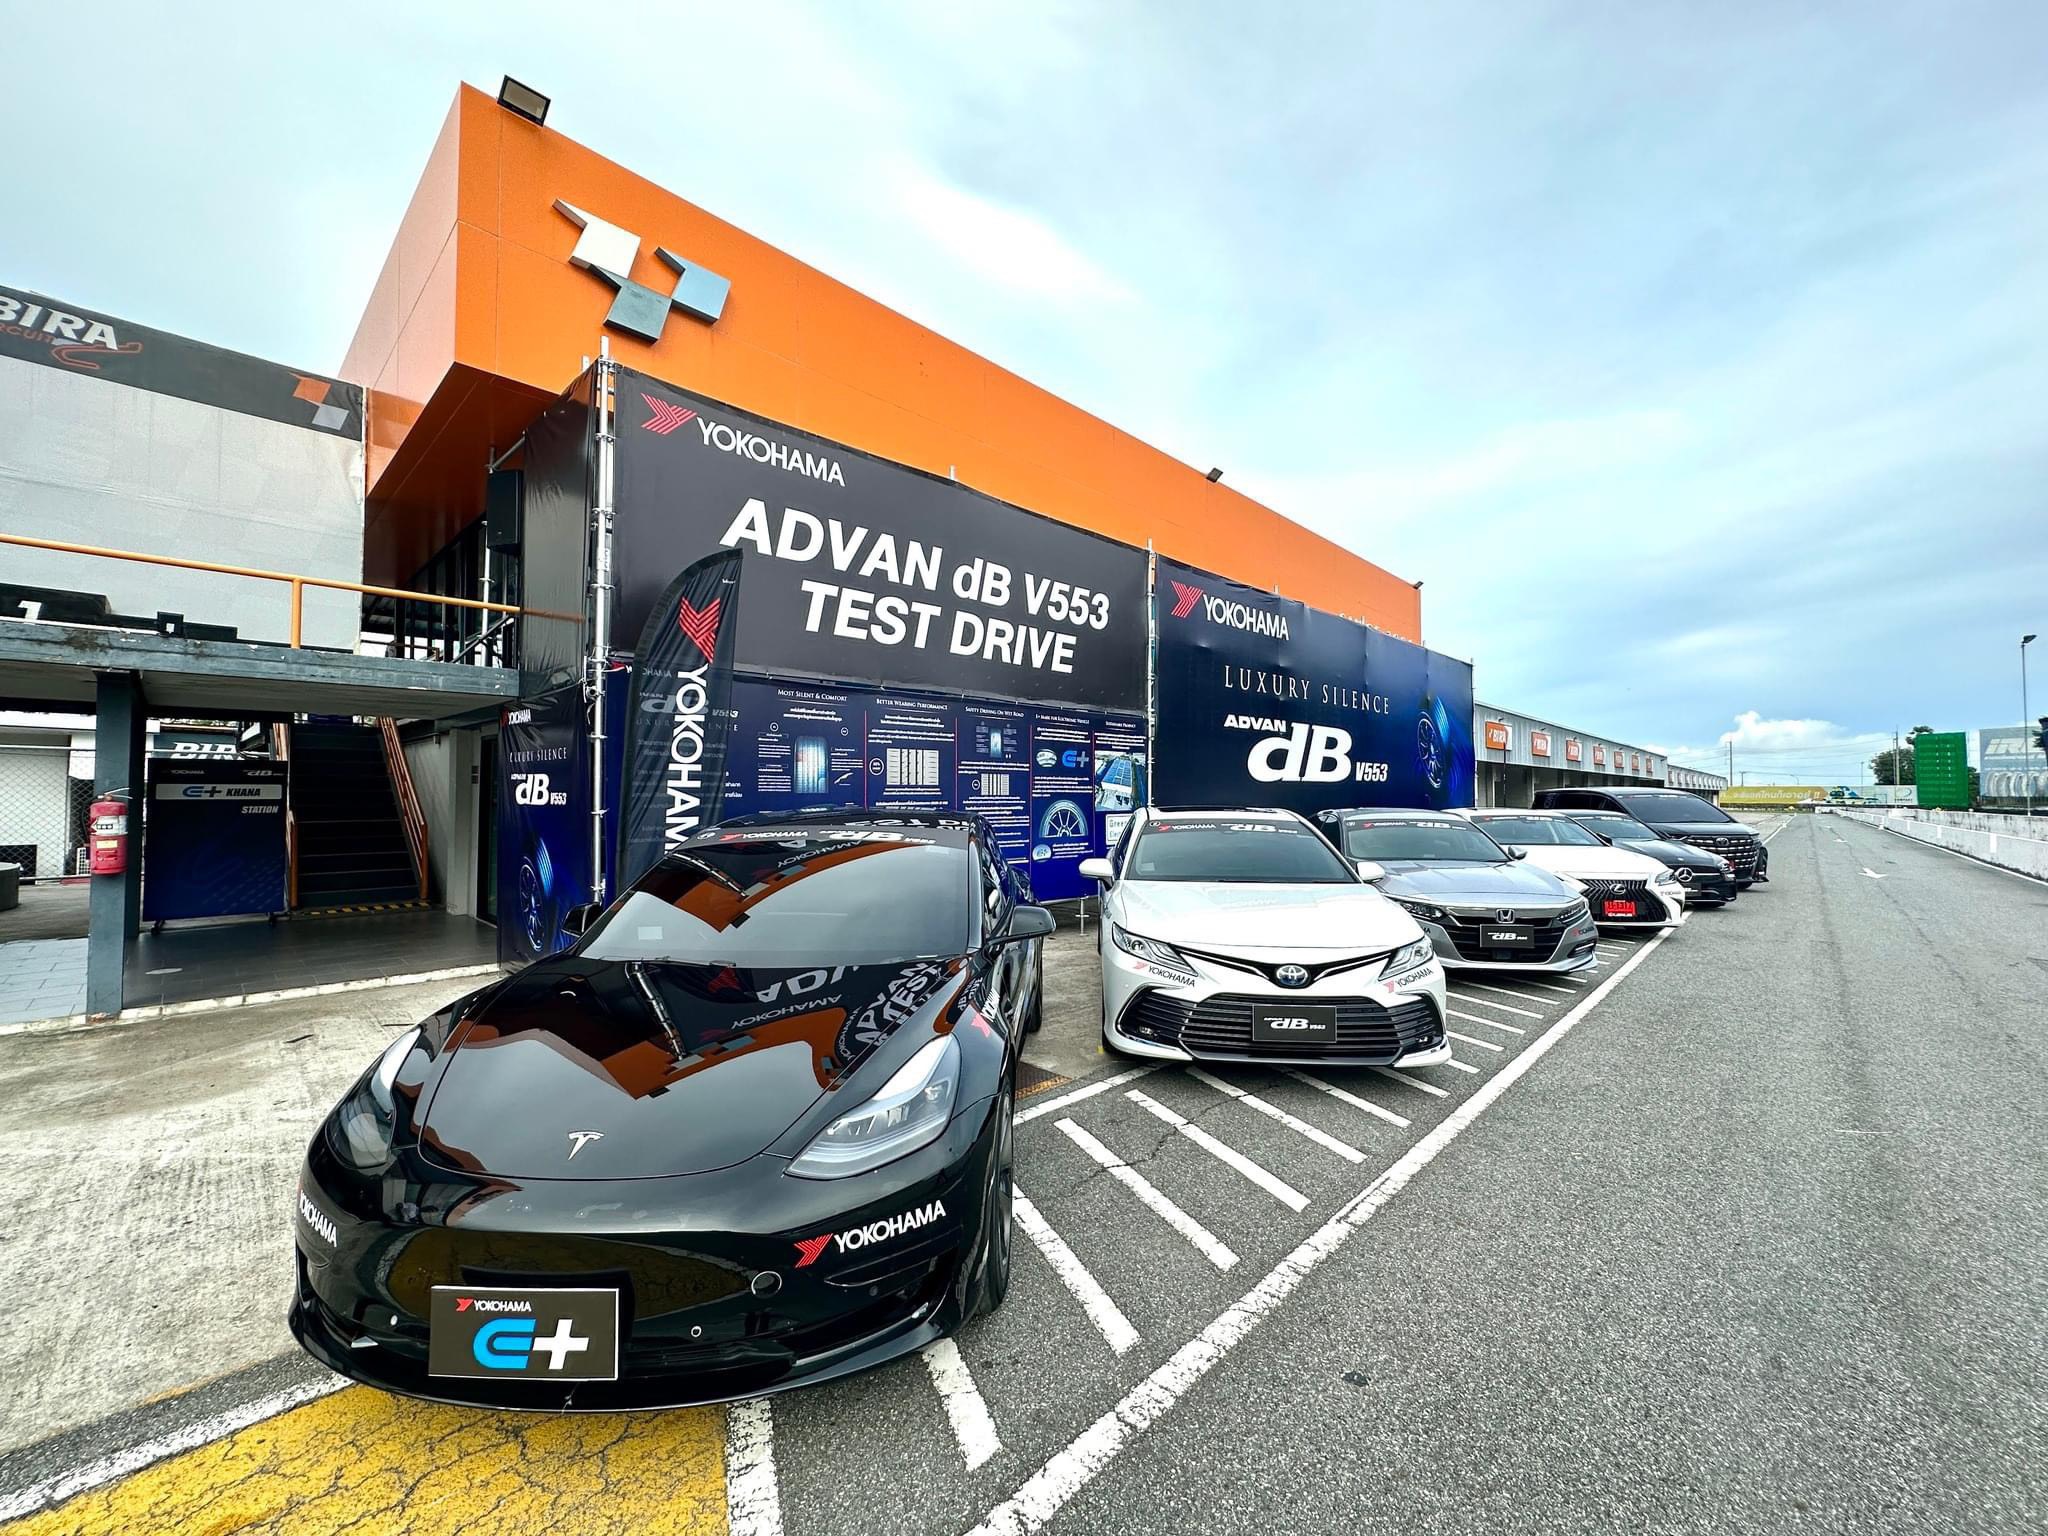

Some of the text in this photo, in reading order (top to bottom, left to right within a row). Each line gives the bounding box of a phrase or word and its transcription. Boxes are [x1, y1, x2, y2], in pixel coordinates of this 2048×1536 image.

[696, 416, 845, 487] YOKOHAMA
[719, 497, 1110, 630] ADVAN dB V553
[801, 579, 1077, 674] TEST DRIVE
[1203, 594, 1289, 641] YOKOHAMA
[778, 689, 794, 697] MOST
[796, 691, 814, 699] SILENT
[822, 693, 847, 702] COMFORT
[1224, 664, 1389, 715] LUXURY SILENCE
[917, 702, 948, 711] PERFORMANCE
[1224, 713, 1287, 733] ADVAN
[536, 747, 567, 761] SILENCE
[663, 663, 709, 855] YOKOHAM
[1247, 722, 1353, 783] dB
[1355, 761, 1389, 782] V553
[226, 788, 262, 797] KHANA
[515, 773, 550, 806] dB
[550, 792, 568, 806] V553
[241, 805, 279, 814] STATION
[742, 831, 809, 839] YOKOHAMA
[1172, 823, 1217, 831] YOKOHAMA
[1148, 965, 1196, 988] YOKOHAMA
[1395, 967, 1434, 988] YOKOHAMA
[1270, 1017, 1310, 1030] dB
[833, 1199, 947, 1254] YOKOHAMA
[473, 1300, 532, 1312] YOKOHAMA
